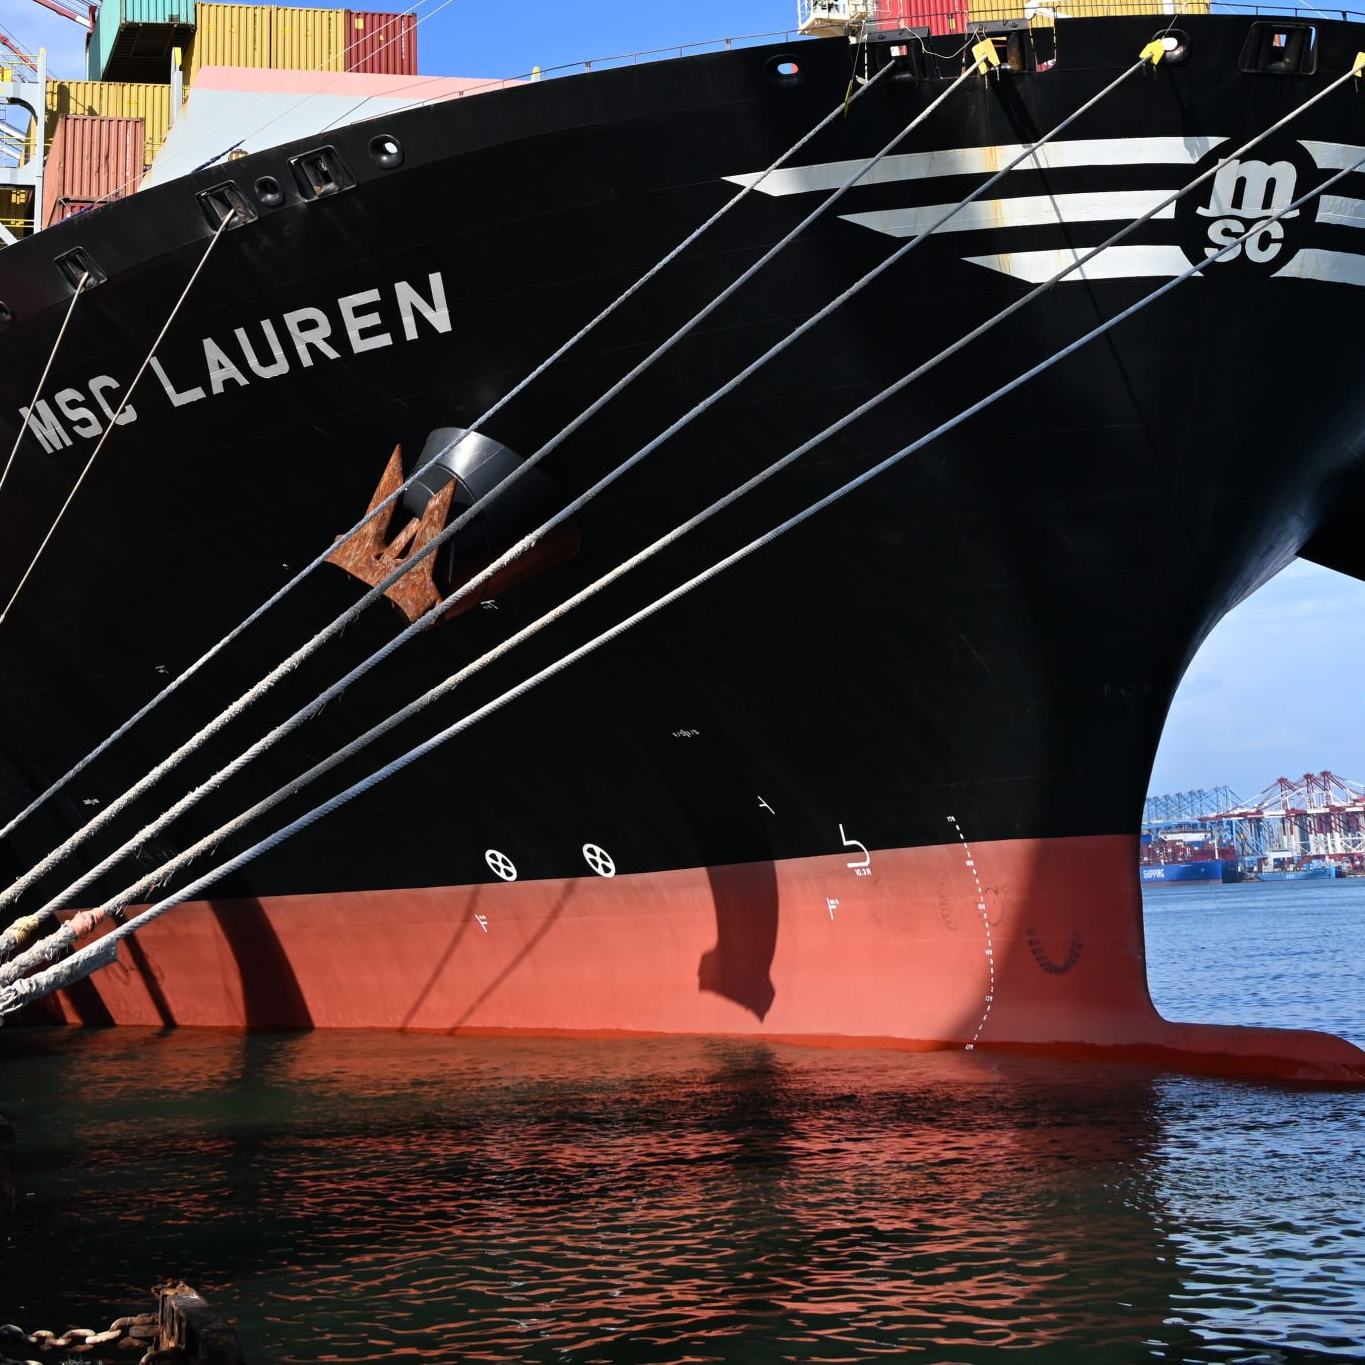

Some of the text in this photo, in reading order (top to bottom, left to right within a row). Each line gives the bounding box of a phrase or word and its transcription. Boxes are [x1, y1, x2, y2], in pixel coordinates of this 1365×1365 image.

[18, 271, 453, 454] MSC LAUREN
[1142, 868, 1165, 879] SHIPPING
